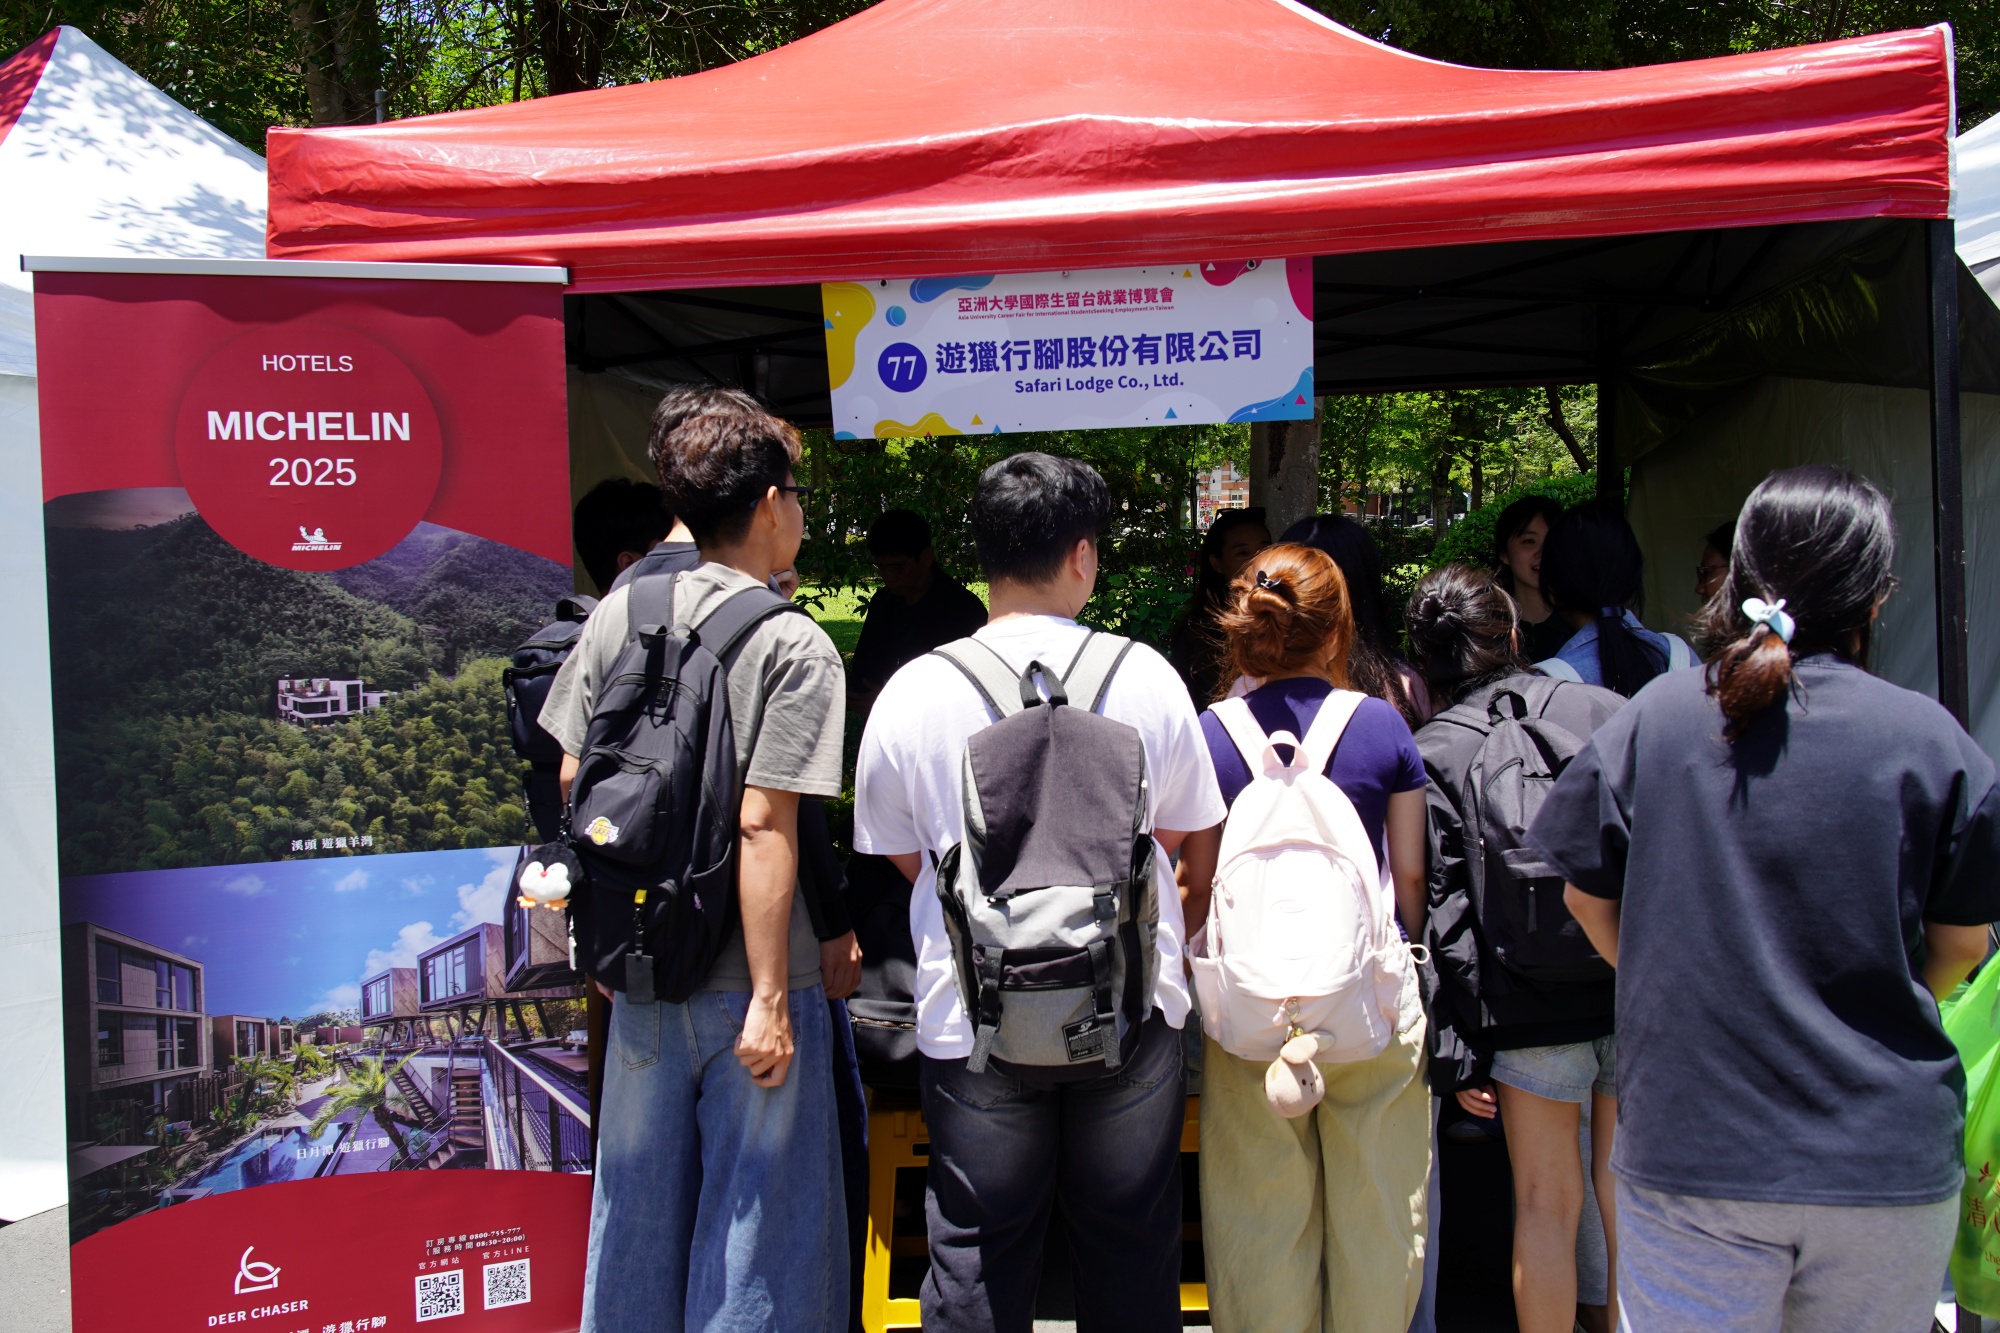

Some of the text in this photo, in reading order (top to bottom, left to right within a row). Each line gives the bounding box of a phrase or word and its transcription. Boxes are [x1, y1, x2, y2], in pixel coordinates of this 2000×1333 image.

[958, 286, 1174, 312] 亞洲大學國際生留台就業博覽會
[262, 354, 353, 372] HOTELS
[936, 329, 1261, 374] 遊獵行腳股份有限公司
[887, 355, 917, 381] 77
[1015, 372, 1184, 393] Safari Lodge Co., Ltd.
[207, 410, 410, 441] MICHELIN
[269, 458, 357, 486] 2025
[291, 839, 317, 852] 溪頭
[296, 1143, 334, 1160] 日月潭
[469, 1227, 521, 1240] 0800-755-777
[418, 1256, 460, 1270] 官方網站
[208, 1299, 309, 1327] DEER CHASER
